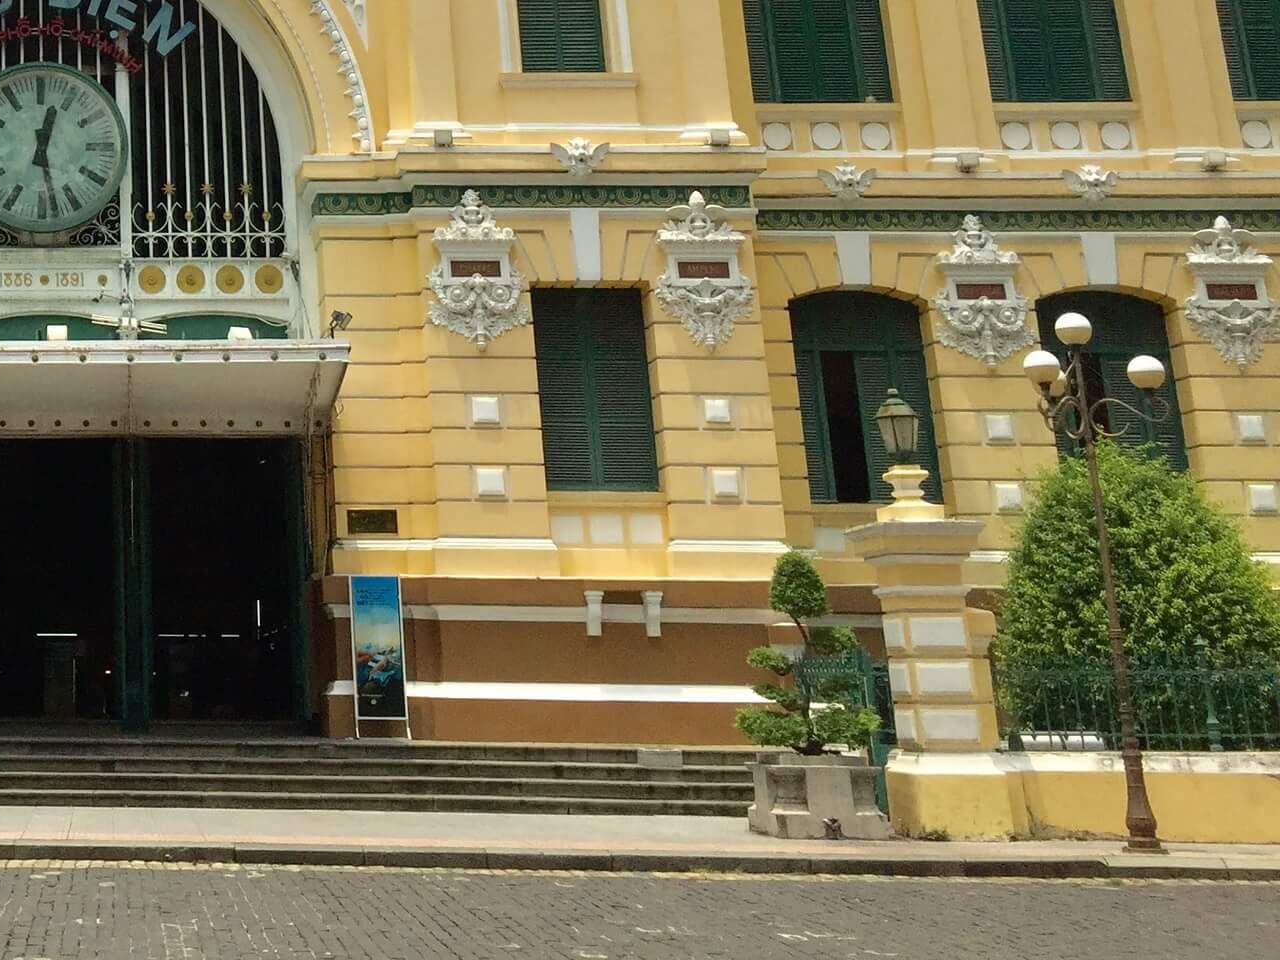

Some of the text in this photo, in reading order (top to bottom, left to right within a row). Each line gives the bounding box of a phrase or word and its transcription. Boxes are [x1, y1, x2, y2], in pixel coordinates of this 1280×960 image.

[99, 40, 143, 74] MINH
[0, 271, 84, 287] 1886 1891
